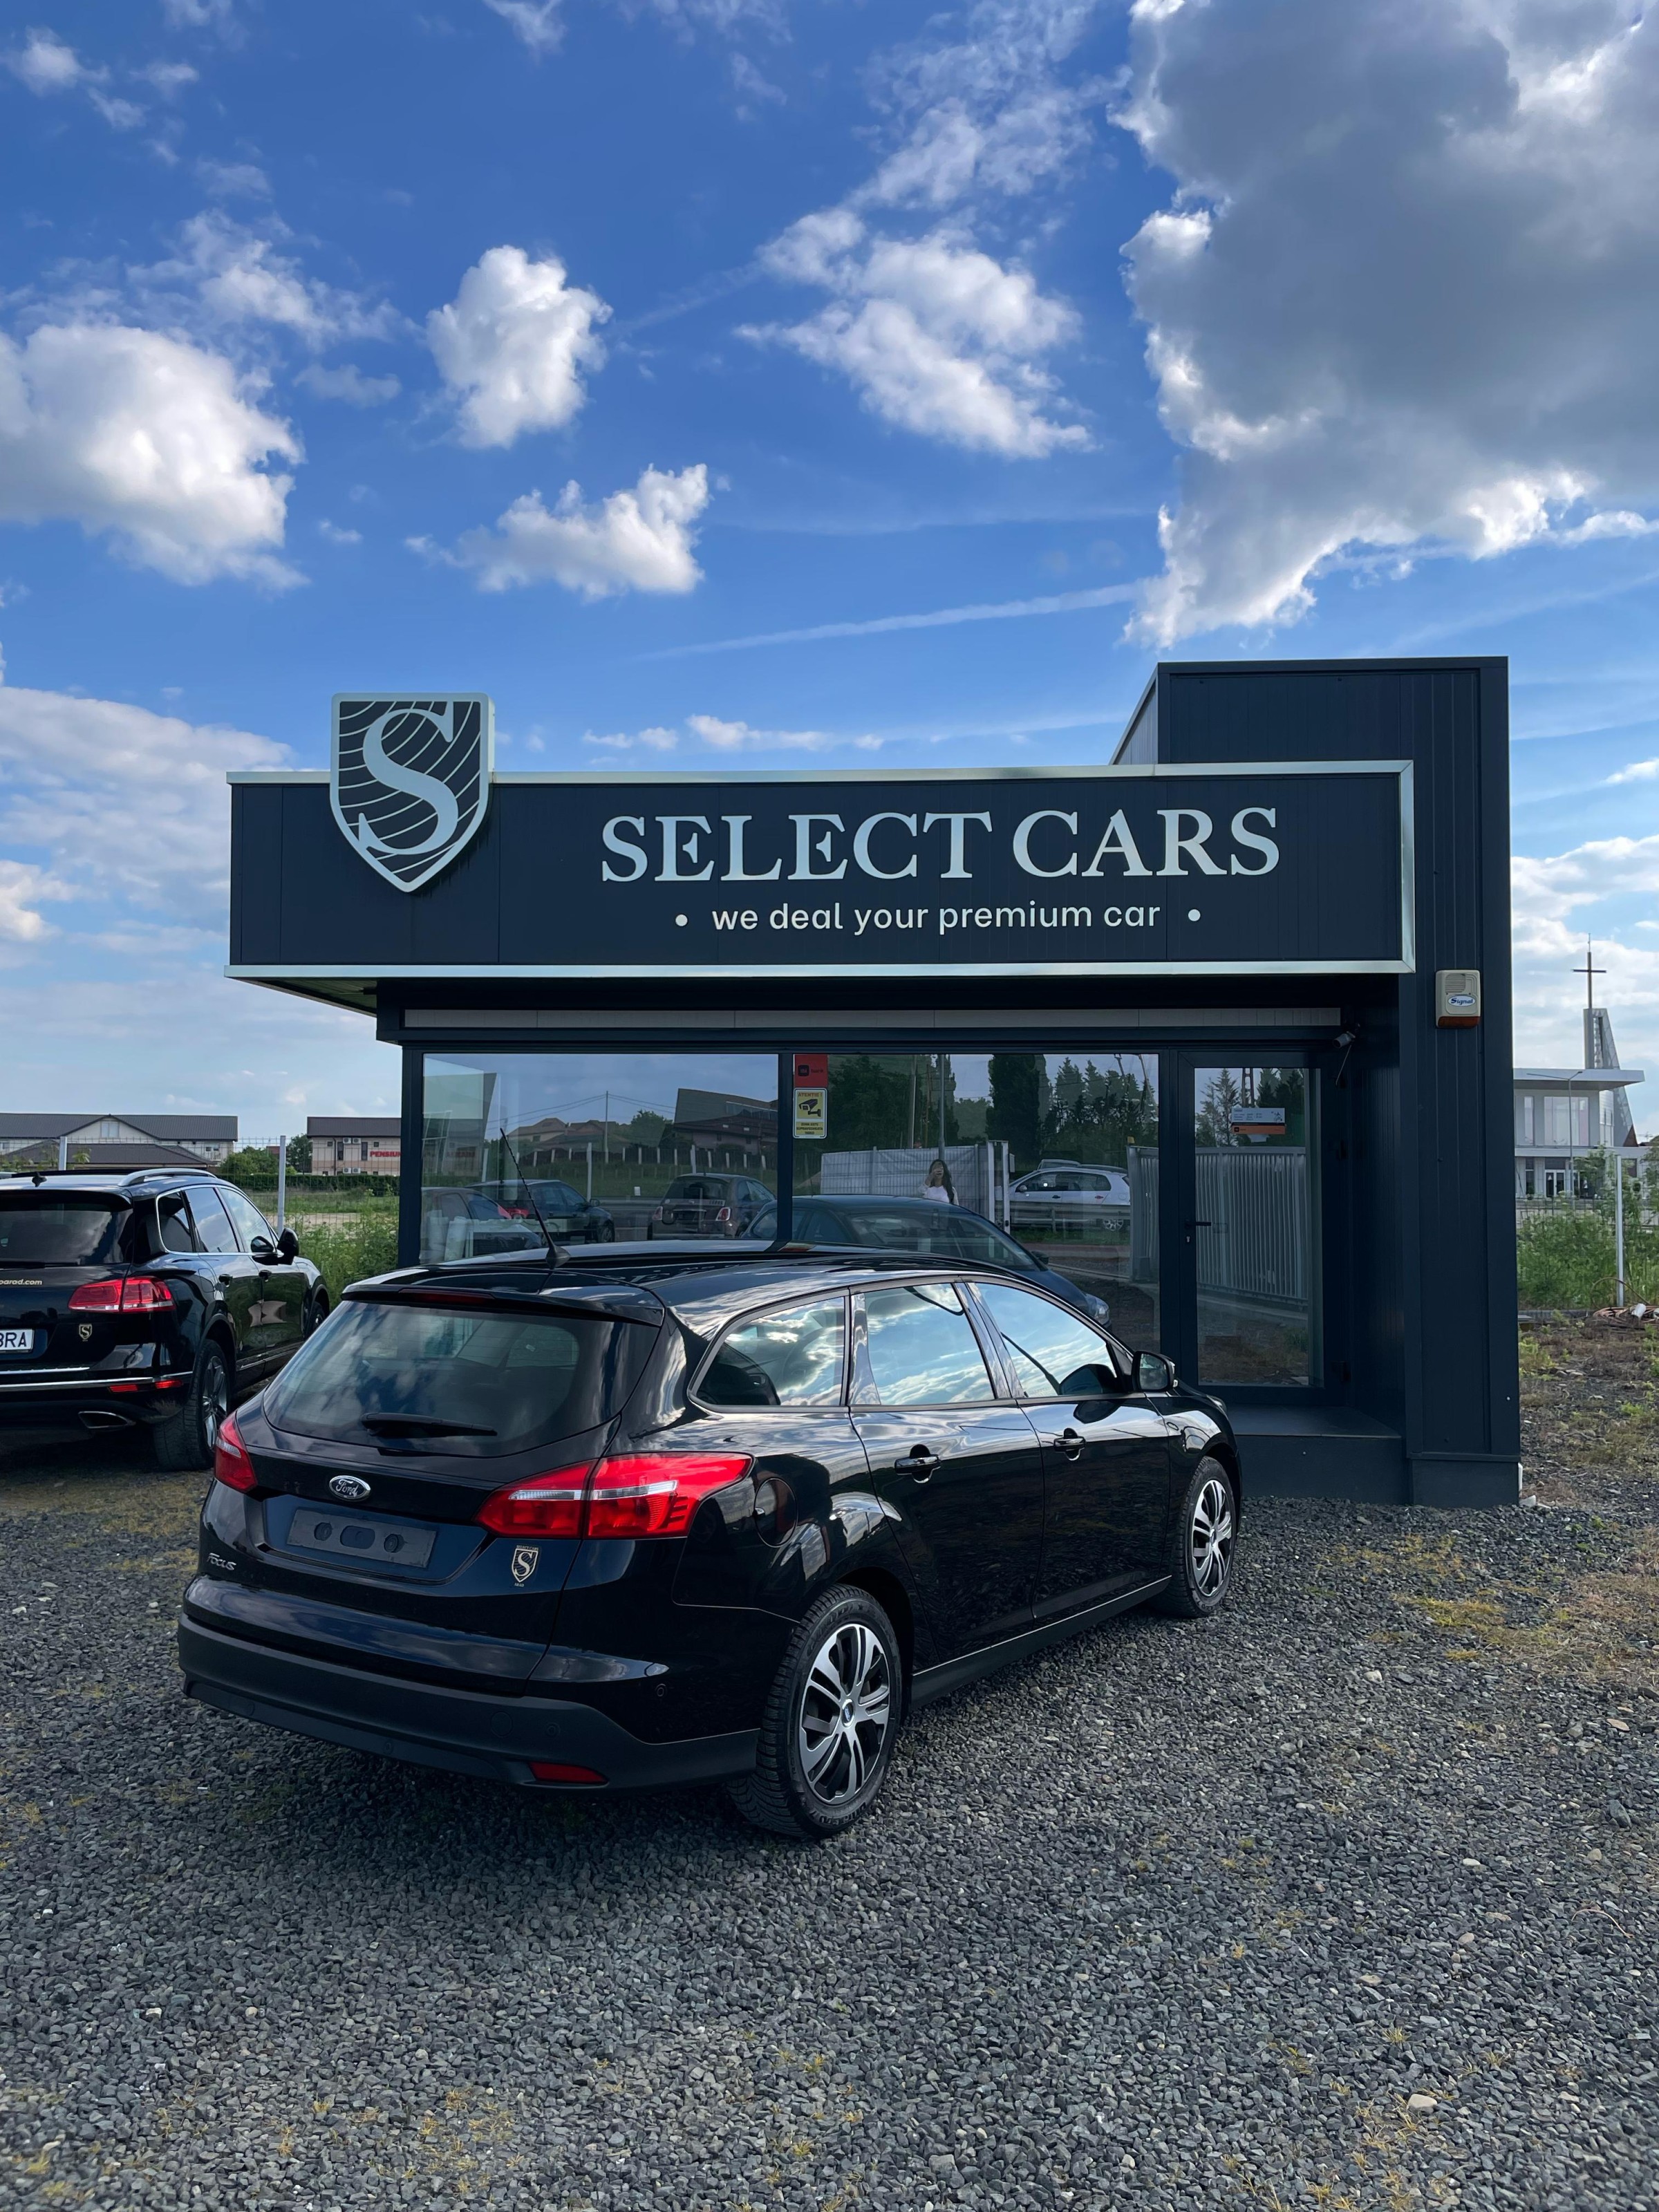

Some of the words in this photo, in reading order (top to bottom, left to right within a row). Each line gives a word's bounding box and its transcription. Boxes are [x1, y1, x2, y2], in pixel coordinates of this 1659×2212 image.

[359, 702, 459, 855] S
[601, 811, 993, 883] SELECT
[1012, 807, 1280, 878] CARS
[712, 909, 759, 930] we
[769, 902, 843, 930] deal
[854, 908, 929, 936] your
[939, 899, 1092, 935] premium
[1103, 906, 1161, 927] car
[1450, 997, 1474, 1006] Signal
[335, 1479, 359, 1495] Ford
